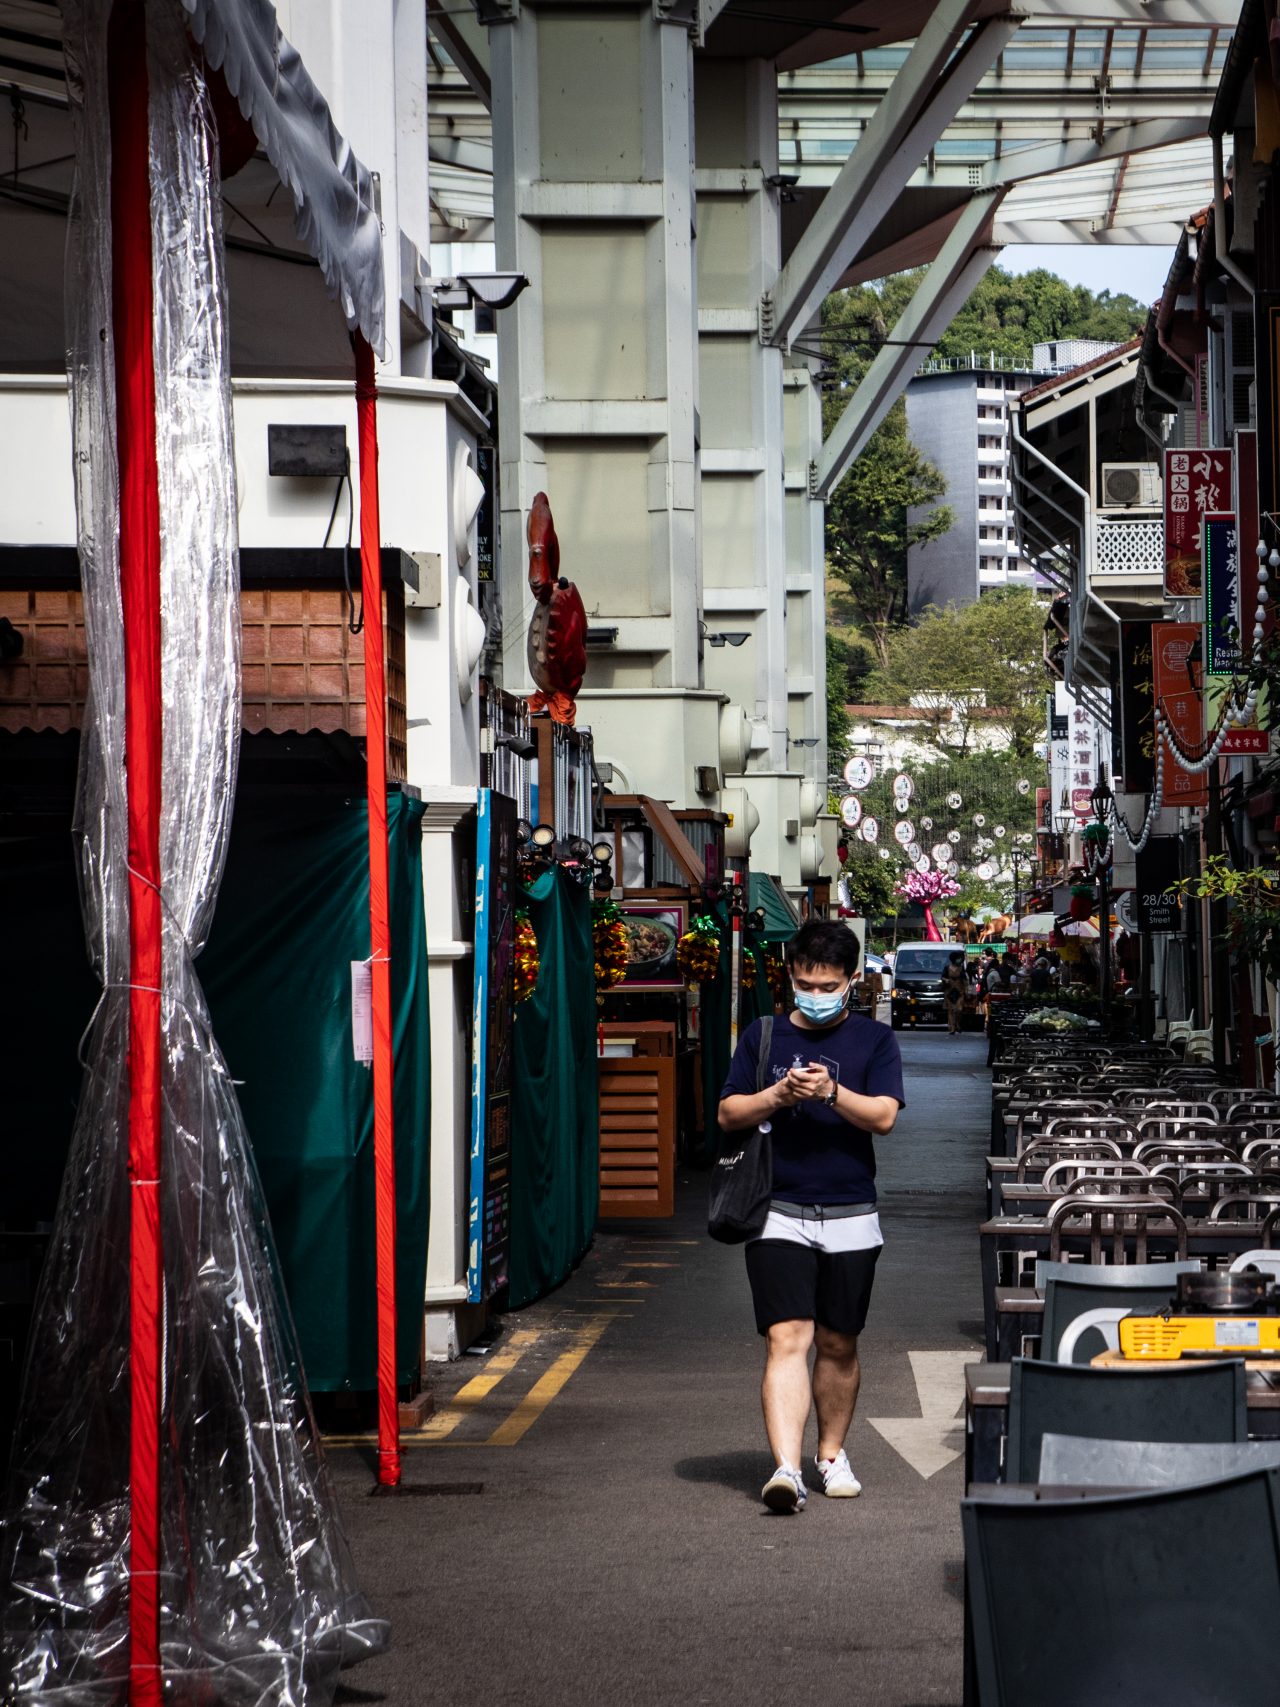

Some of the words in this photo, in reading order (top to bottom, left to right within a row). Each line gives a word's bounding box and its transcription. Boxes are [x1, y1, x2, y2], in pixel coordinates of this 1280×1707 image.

[1172, 455, 1189, 511] 老火锅
[1142, 893, 1176, 907] 28/30
[1149, 907, 1170, 916] Smith
[1148, 916, 1171, 924] Street
